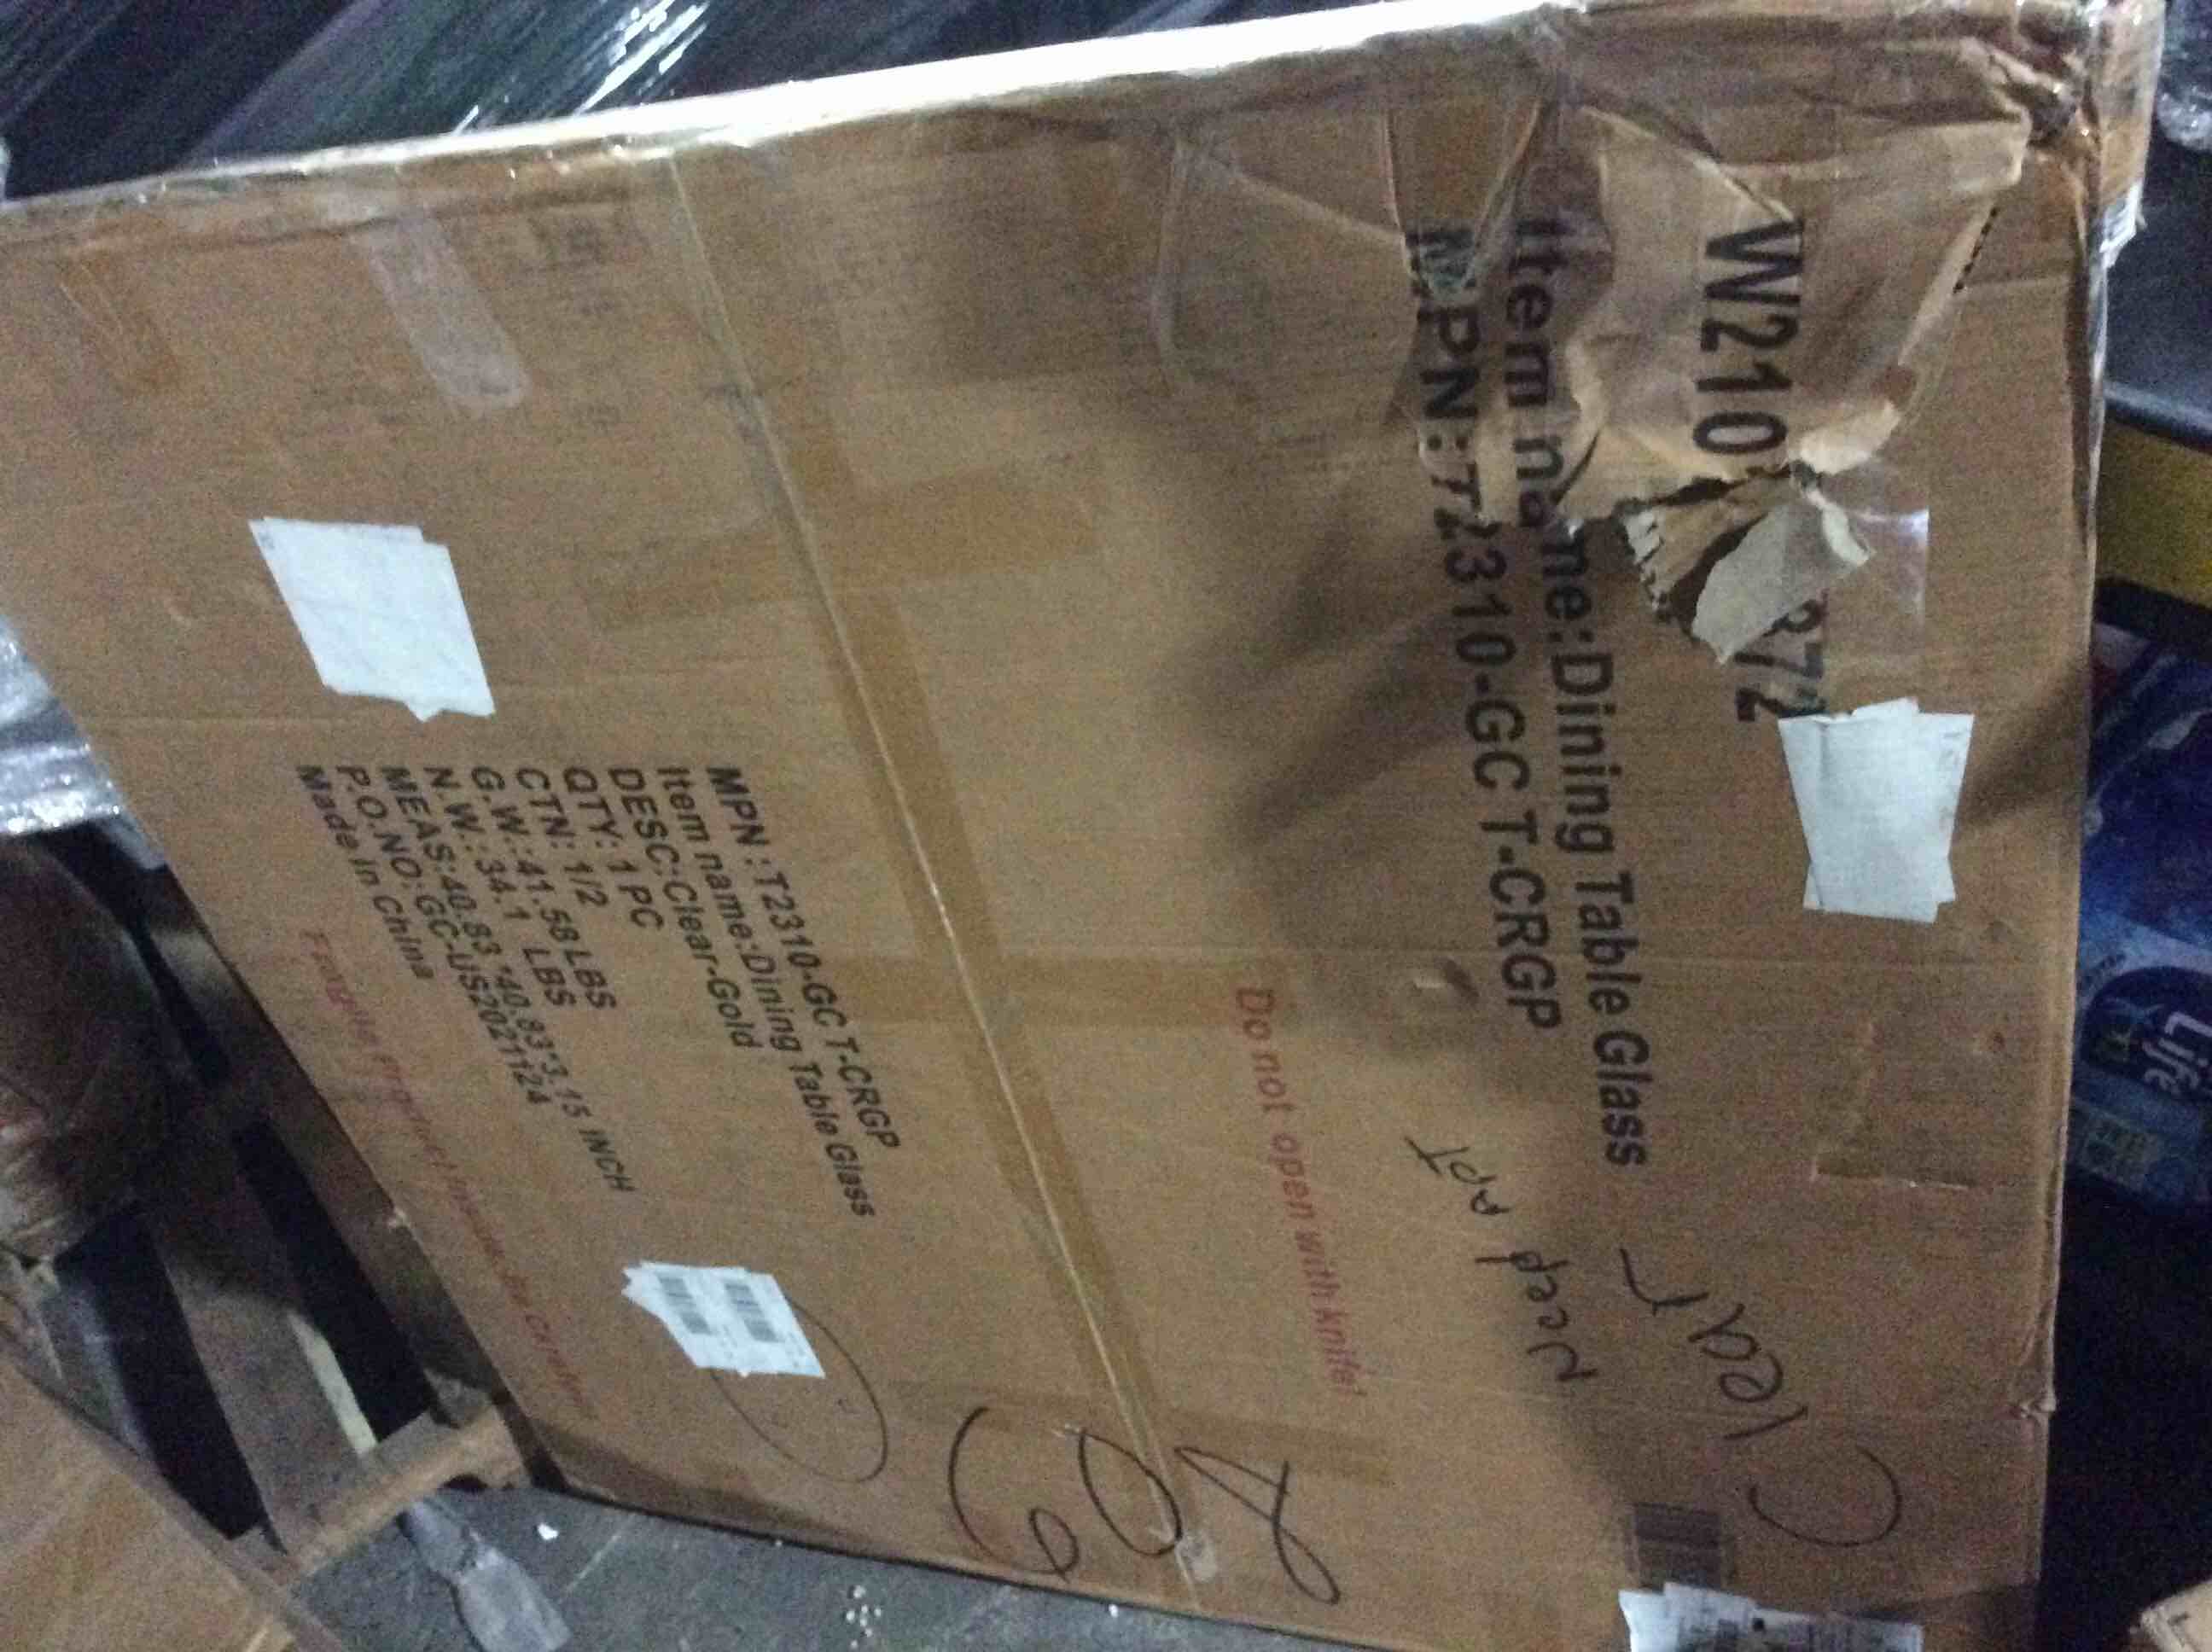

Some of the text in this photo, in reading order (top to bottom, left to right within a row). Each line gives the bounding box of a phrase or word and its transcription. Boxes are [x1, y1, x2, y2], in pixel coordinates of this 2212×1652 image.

[1504, 218, 1569, 408] Item
[296, 766, 360, 852] Made
[374, 893, 434, 979] China
[515, 766, 609, 909] CTN: 1/2
[563, 766, 664, 930] QTY: 1 PC
[522, 945, 577, 1009] LBS
[1479, 809, 1563, 1029] T-CRGP
[1575, 871, 1641, 1015] Table
[657, 766, 710, 858] Item
[790, 1062, 838, 1137] Table
[826, 1143, 875, 1219] Glass
[1236, 986, 1275, 1042] Do
[825, 1038, 901, 1150] T-CRGP
[1254, 1054, 1297, 1117] not
[1592, 1030, 1653, 1167] Glass
[580, 1128, 635, 1193] INCH
[1269, 1131, 1318, 1224] open
